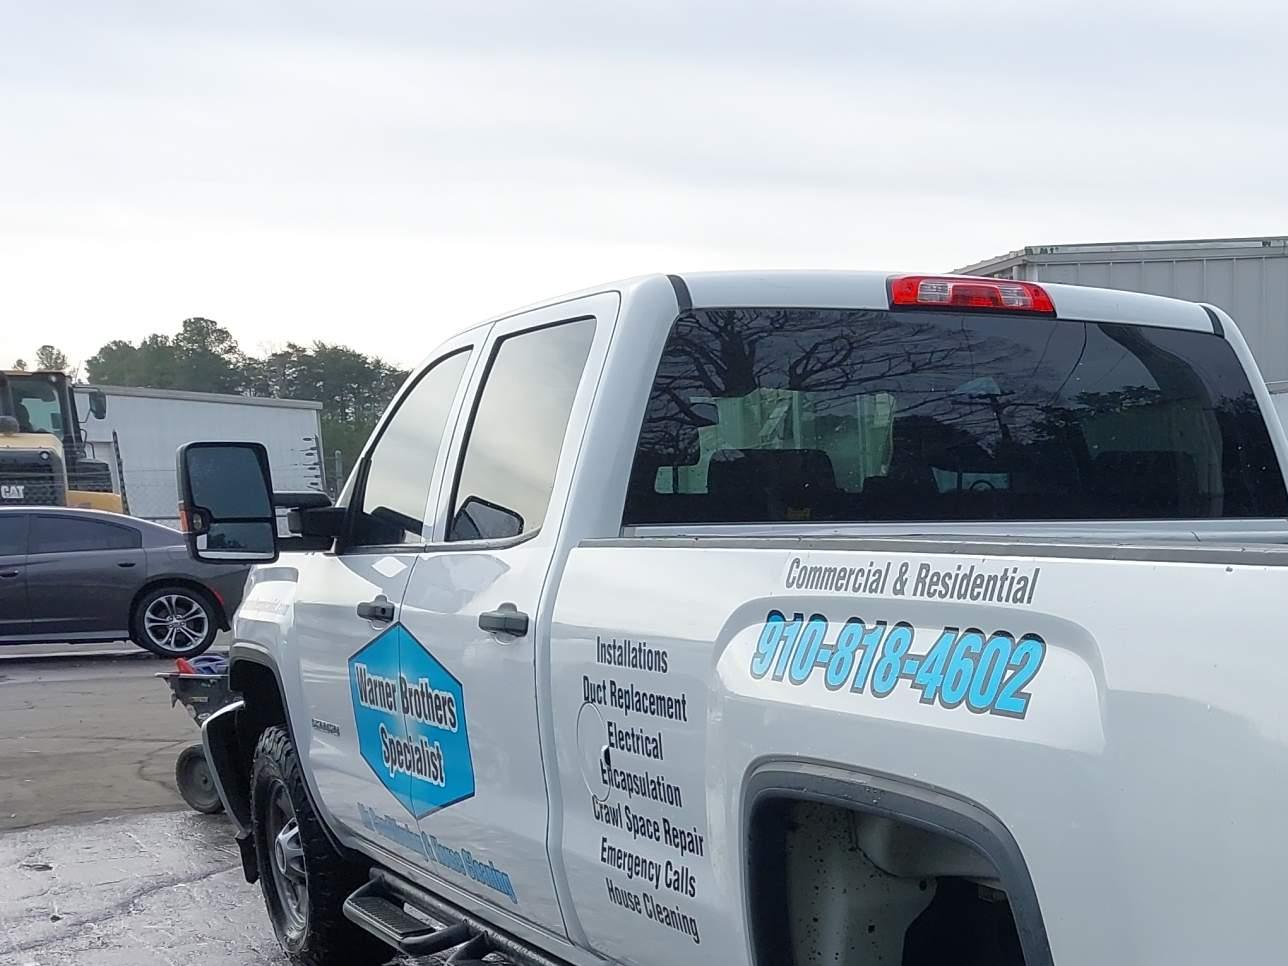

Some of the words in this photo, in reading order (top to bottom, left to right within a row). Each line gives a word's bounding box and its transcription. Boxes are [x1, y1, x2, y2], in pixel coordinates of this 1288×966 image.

[0, 485, 25, 499] CAT
[785, 557, 889, 596] Commercial
[893, 562, 909, 595] &
[912, 562, 1041, 605] Residential
[596, 636, 669, 674] Installations
[749, 608, 1047, 719] 910-818-4602
[356, 665, 397, 712] Warner
[399, 676, 456, 730] Brothers
[583, 675, 607, 707] Duct
[609, 679, 688, 723] Replacement
[381, 727, 444, 785] Specialist
[607, 721, 664, 761] Electrical
[600, 757, 683, 809] Encapsulation
[592, 795, 624, 830] Crawl
[625, 805, 661, 842] Space
[661, 817, 706, 859] Repair
[601, 837, 662, 890] Emergency
[664, 860, 696, 899] Calls
[606, 877, 642, 915] House
[643, 891, 701, 945] Cleaning
